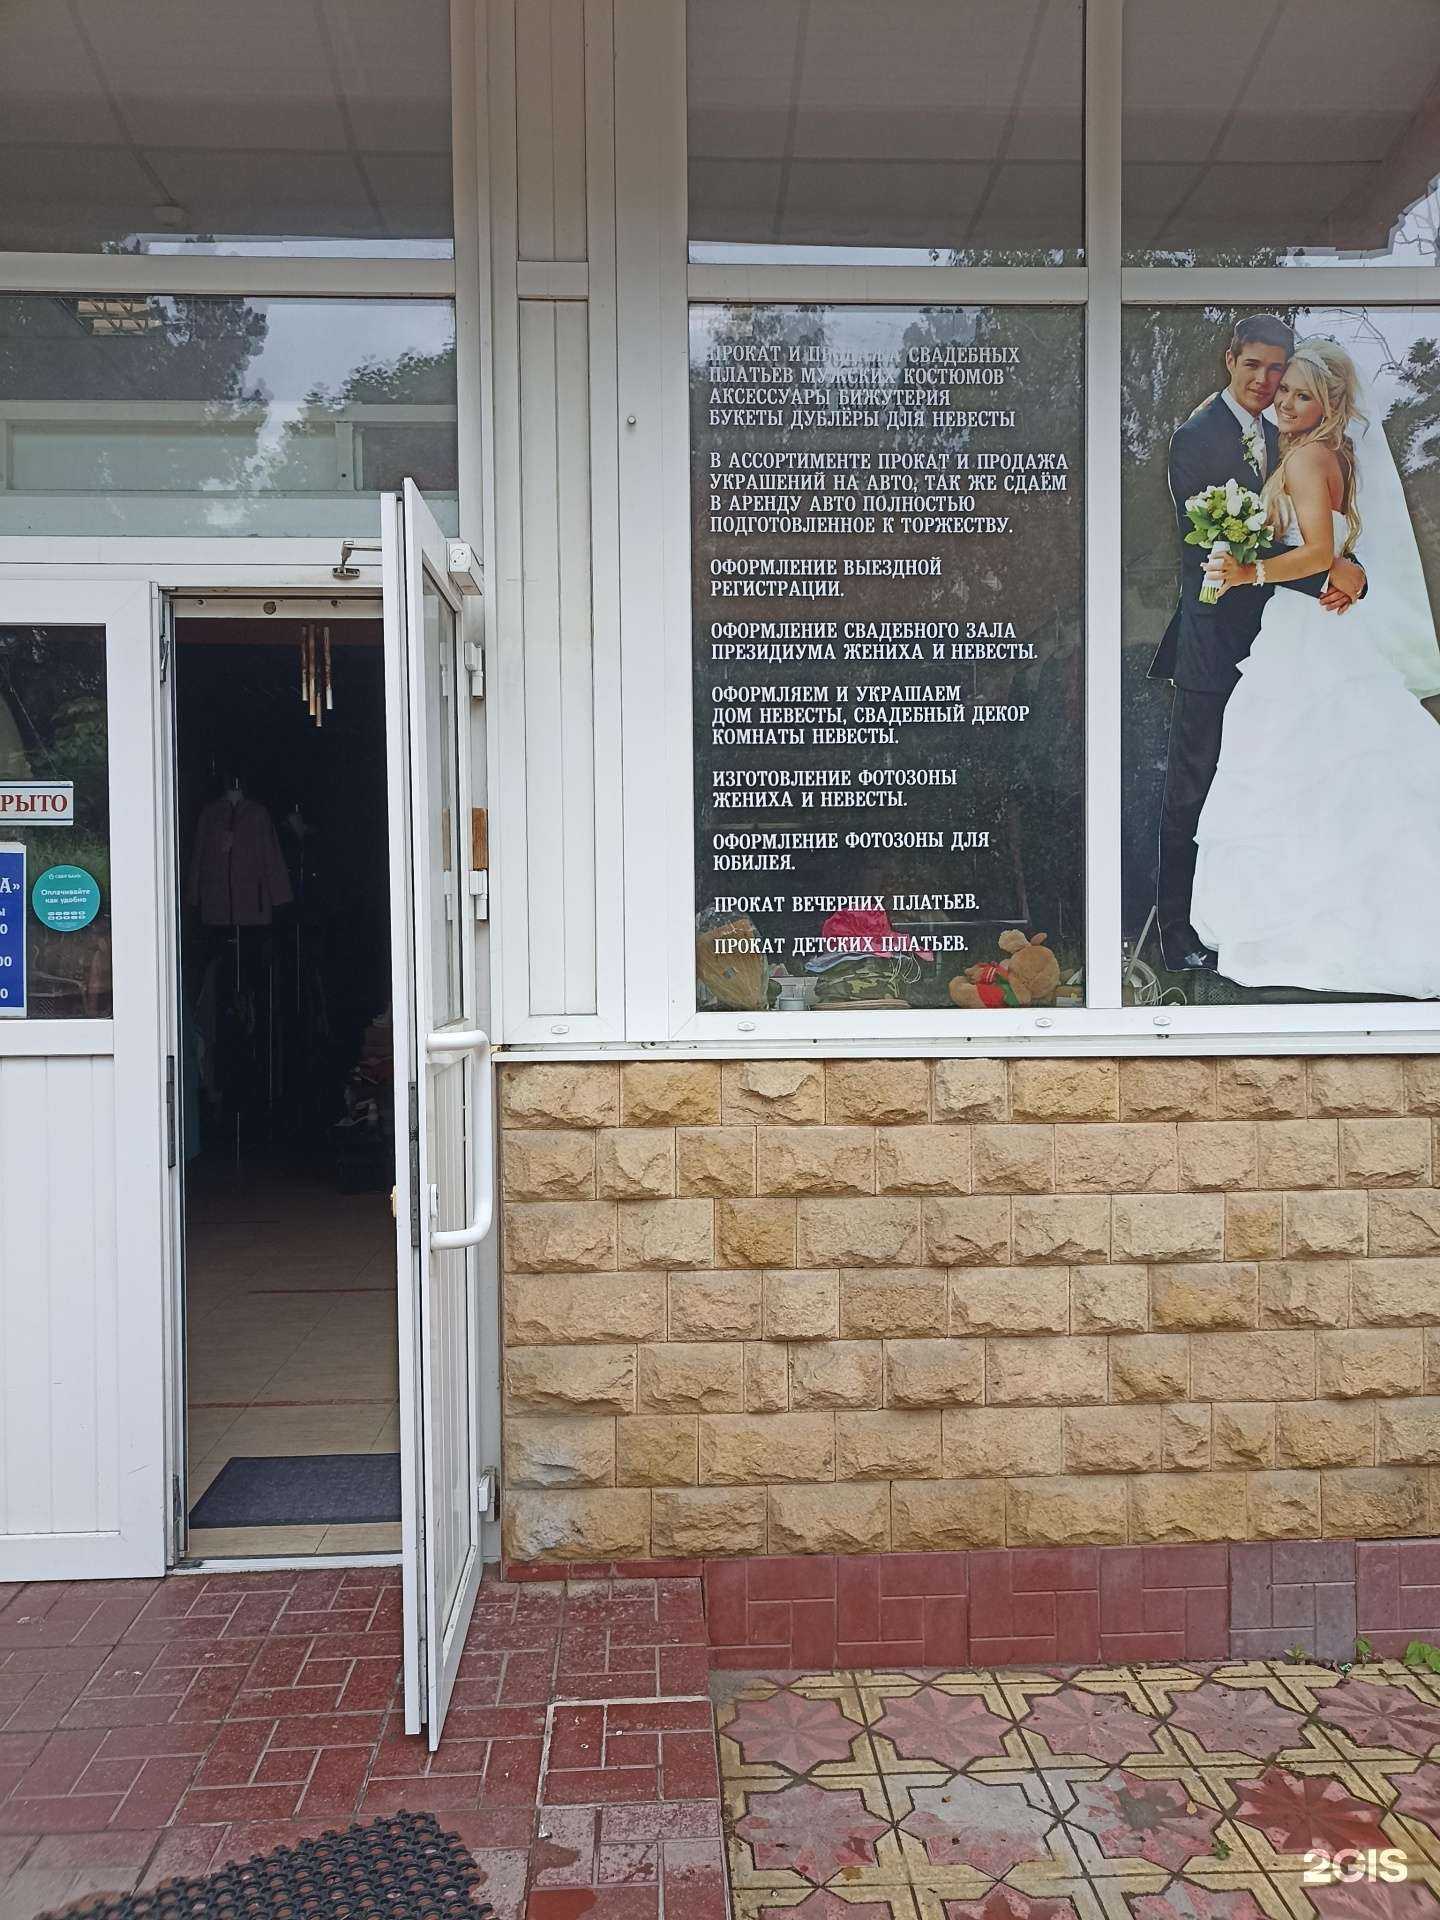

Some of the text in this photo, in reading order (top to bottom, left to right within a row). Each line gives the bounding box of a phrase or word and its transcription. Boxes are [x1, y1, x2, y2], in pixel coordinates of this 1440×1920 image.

[708, 346, 781, 362] ПРОКАТ
[789, 346, 800, 361] И
[909, 347, 1020, 366] СВАДЕБНЫХ
[709, 367, 1004, 385] ПЛАТЬЕВ МУЖСКИХ КОСТЮМОВ
[709, 388, 951, 406] АКСЕССУАРЫ БИЖУТЕРИЯ
[709, 408, 1016, 430] БУКЕТЫ ДУБЛЁРЫ ДЛЯ НЕВЕСТЫ
[710, 453, 1069, 473] В АССОРТИМЕНТЕ ПРОКАТ И ПРОДАЖА
[710, 472, 1067, 494] УКРАШЕНИЙ НА АВТО, ТАК ЖЕ СДАЁМ
[710, 496, 975, 514] В АРЕНДУ АВТО ПОЛНОСТЬЮ
[710, 518, 1013, 536] ПОДГОТОВЛЕННОЕ К ТОРЖЕСТВУ.
[710, 557, 942, 578] ОФОРМЛЕНИЕ ВЫЕЗДНОЙ
[711, 581, 844, 599] РЕГИСТРАЦИИ.
[711, 623, 1016, 642] ОФОРМЛЕНИЕ СВАДЕБНОГО ЗАЛА
[711, 644, 1038, 663] ПРЕЗИДИУМА ЖЕНИХА И НЕВЕСТЫ.
[712, 686, 961, 702] ОФОРМЛЯЕМ И УКРАШАЕМ
[712, 704, 1030, 727] ДОМ НЕВЕСТЫ, СВАДЕБНЫЙ ДЕКОР
[712, 729, 898, 745] КОМНАТЫ НЕВЕСТЫ.
[712, 769, 957, 787] ИЗГОТОВЛЕНИЕ ФОТОЗОНЫ
[713, 791, 907, 808] ЖЕНИХА И НЕВЕСТЫ.
[713, 832, 989, 851] ОФОРМЛЕНИЕ ФОТОЗОНЫ ДЛЯ
[713, 855, 795, 871] ЮБИЛЕЯ.
[41, 888, 91, 896] Оплачивайте
[60, 896, 87, 904] удобно
[714, 894, 980, 912] ПРОКАТ ВЕЧЕРНИХ ПЛАТЬЕВ.
[714, 936, 968, 956] ПРОКАТ ДЕТСКИХ ПЛАТЬЕВ.
